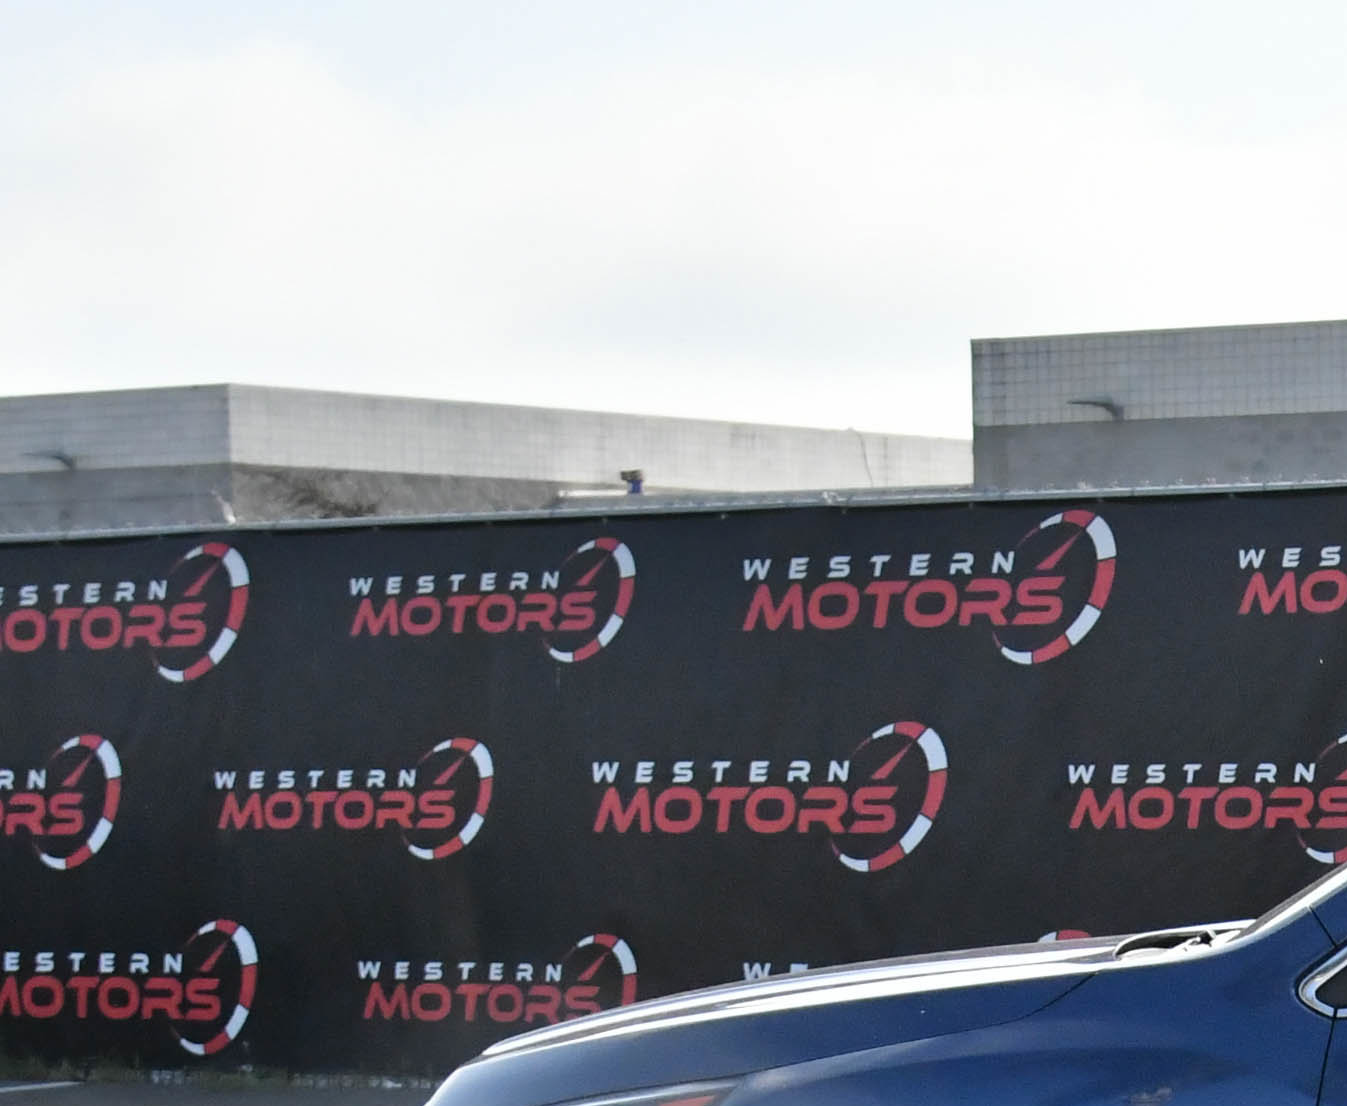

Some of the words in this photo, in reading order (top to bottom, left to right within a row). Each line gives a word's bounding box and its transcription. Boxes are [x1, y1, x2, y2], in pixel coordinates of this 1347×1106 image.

[744, 551, 1015, 581] WESTERN
[0, 580, 168, 606] STERN
[350, 571, 560, 596] WESTERN
[350, 592, 596, 637] MOTORS
[743, 576, 1066, 632] MOTORS
[0, 602, 208, 652] OTORS
[214, 768, 417, 789] WESTERN
[592, 761, 850, 784] WESTERN
[1068, 763, 1316, 785] WESTERN
[218, 789, 456, 830] MOTORS
[592, 786, 898, 834] MOTORS
[357, 961, 562, 982] WESTERN
[363, 982, 601, 1024] MOTORS
